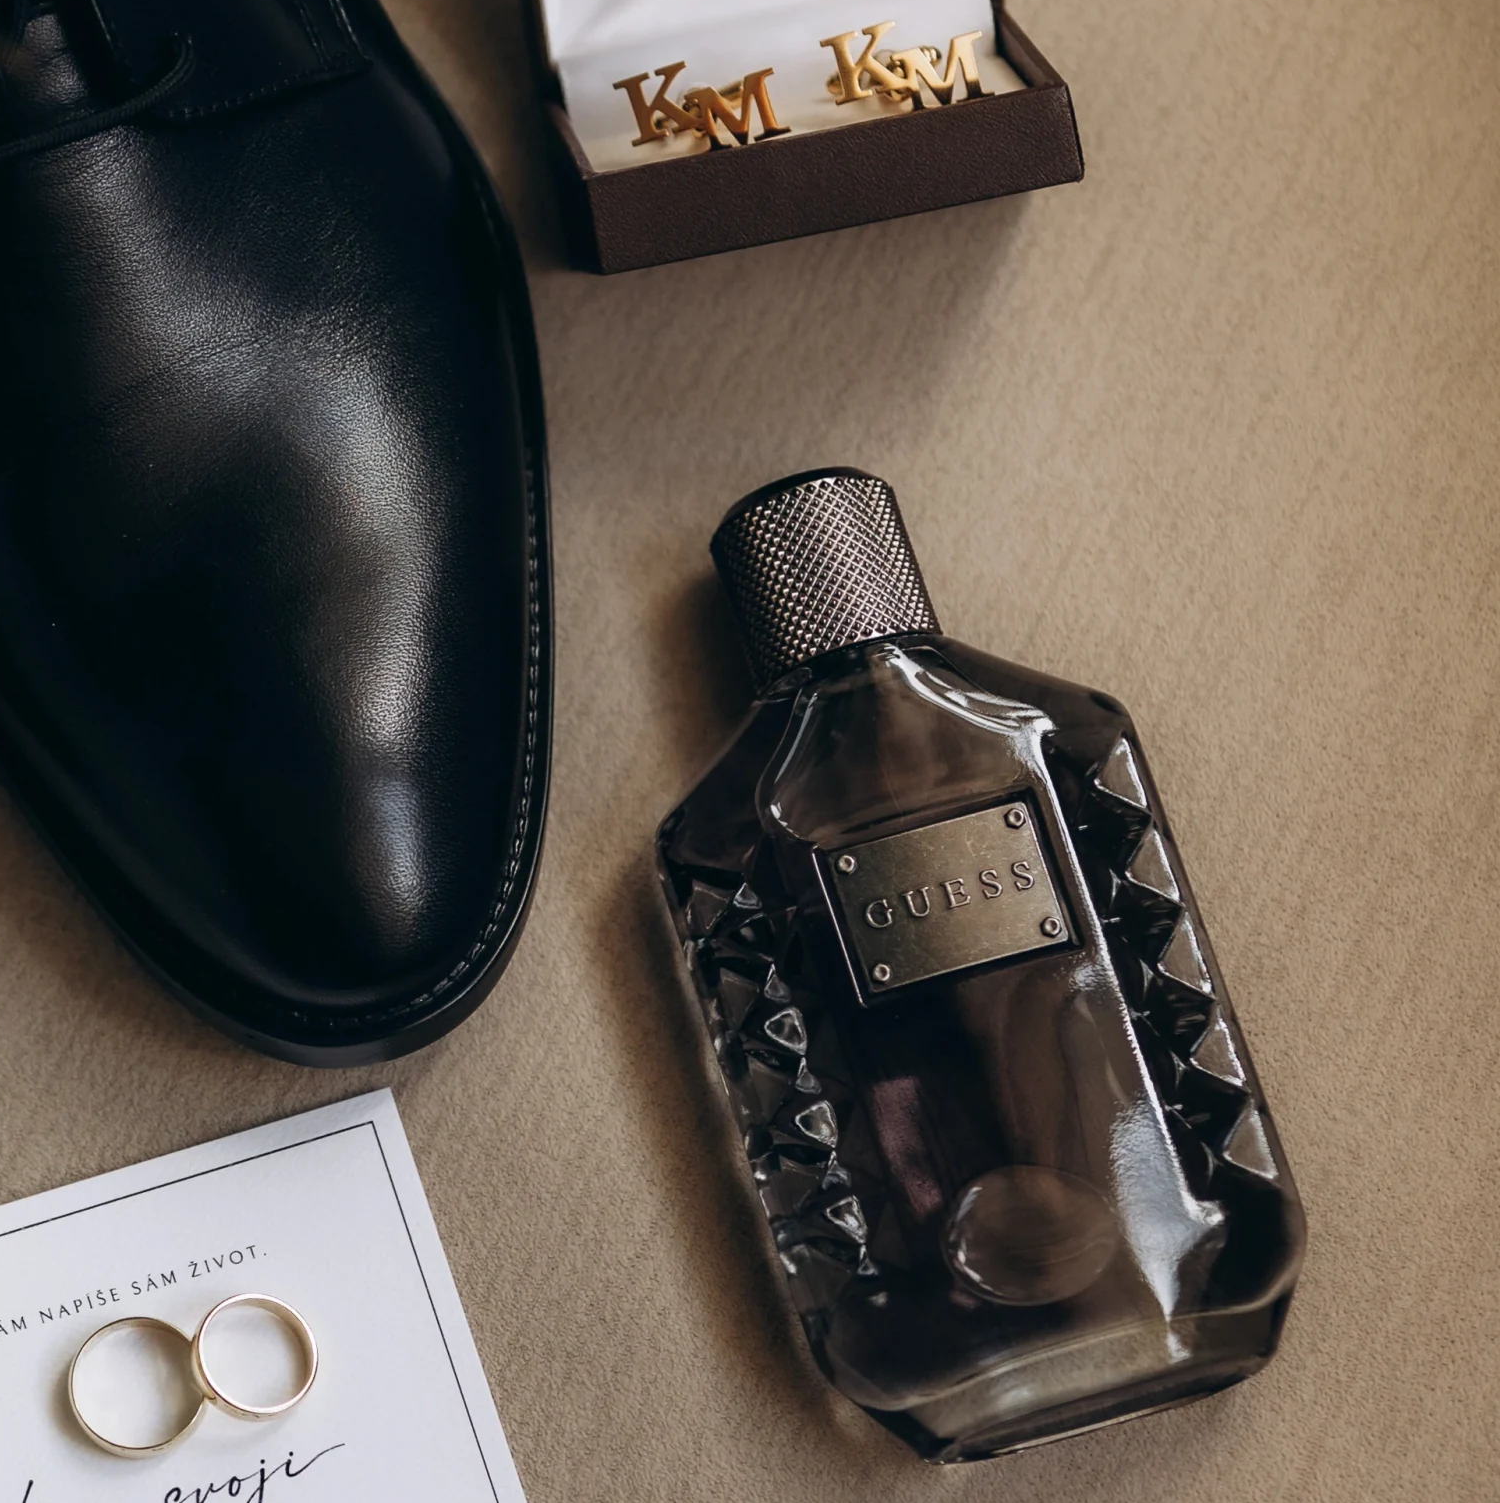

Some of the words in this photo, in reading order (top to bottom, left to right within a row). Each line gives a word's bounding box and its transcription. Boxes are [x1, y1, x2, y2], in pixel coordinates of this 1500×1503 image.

[864, 860, 1036, 929] GUESS
[38, 1287, 122, 1325] NAPÍŠE
[130, 1273, 178, 1296] SÁM
[187, 1244, 268, 1279] ŽIVOT.
